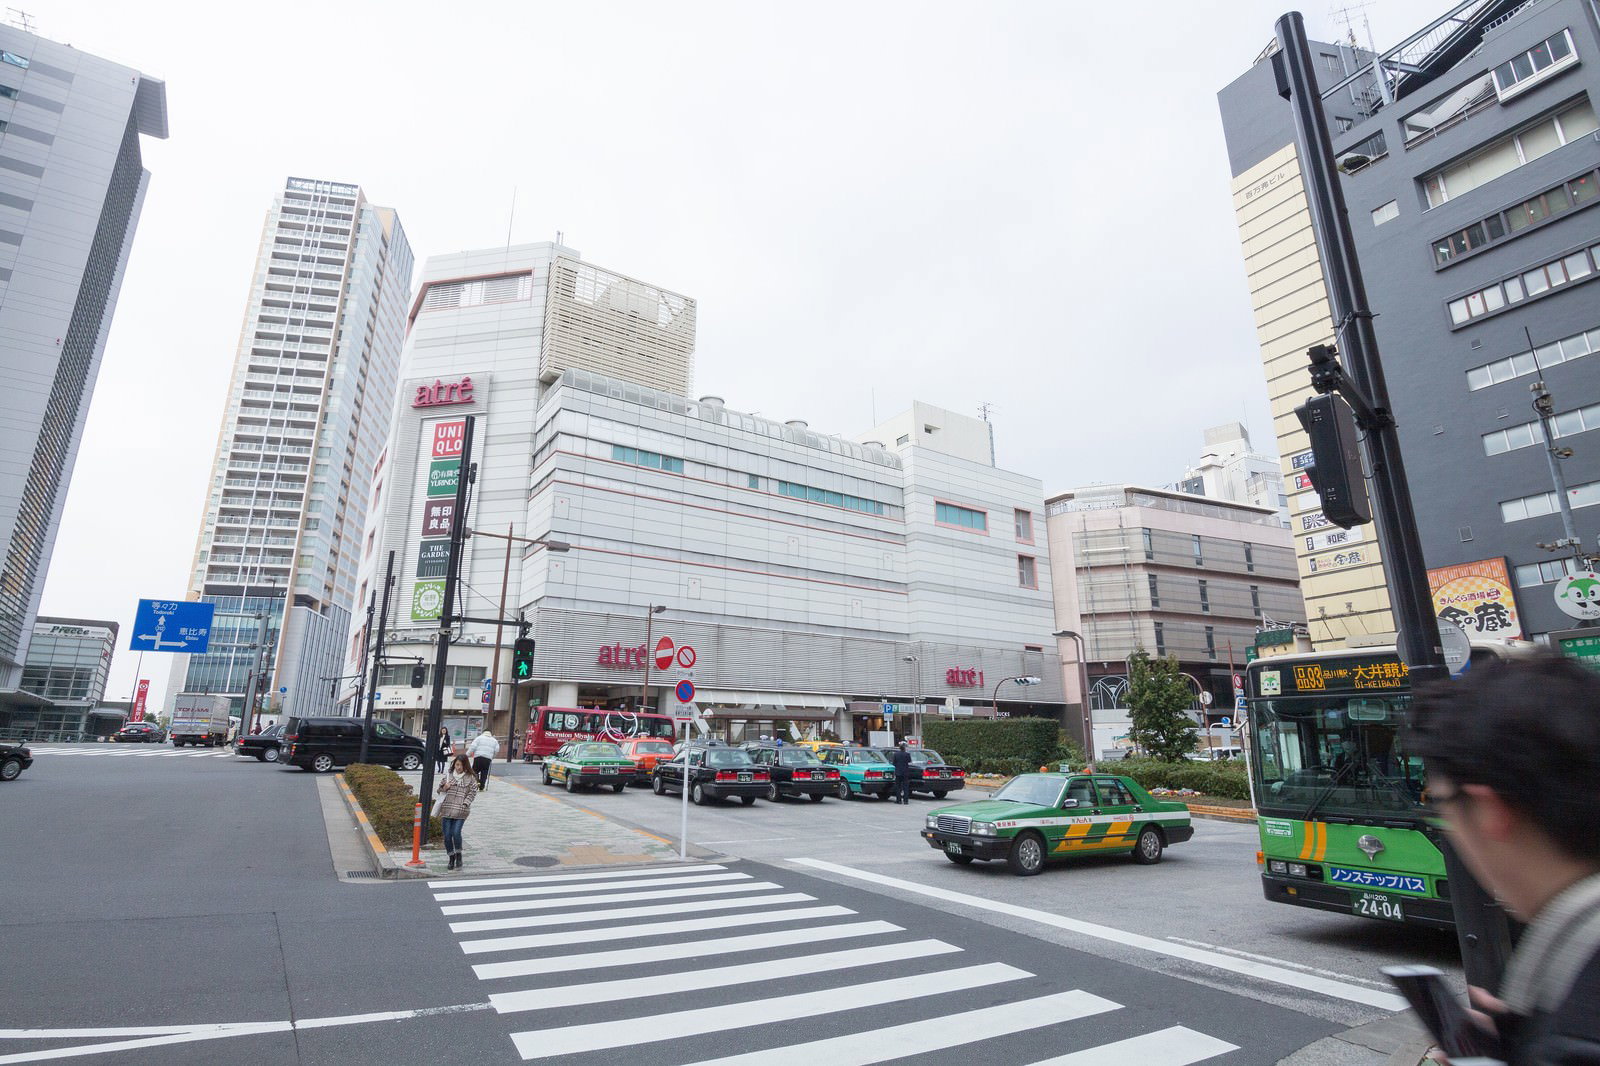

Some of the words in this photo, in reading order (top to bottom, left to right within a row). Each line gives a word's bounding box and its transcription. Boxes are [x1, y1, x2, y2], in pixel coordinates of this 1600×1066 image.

[414, 376, 472, 406] atré
[437, 425, 462, 438] UNI
[436, 438, 463, 455] QLO
[430, 506, 452, 517] 無印
[428, 518, 450, 530] 良品
[421, 551, 450, 559] GARDEN
[179, 627, 207, 637] 恵比寿
[1332, 869, 1425, 892] ノンステップバス
[1359, 899, 1402, 919] 24-04
